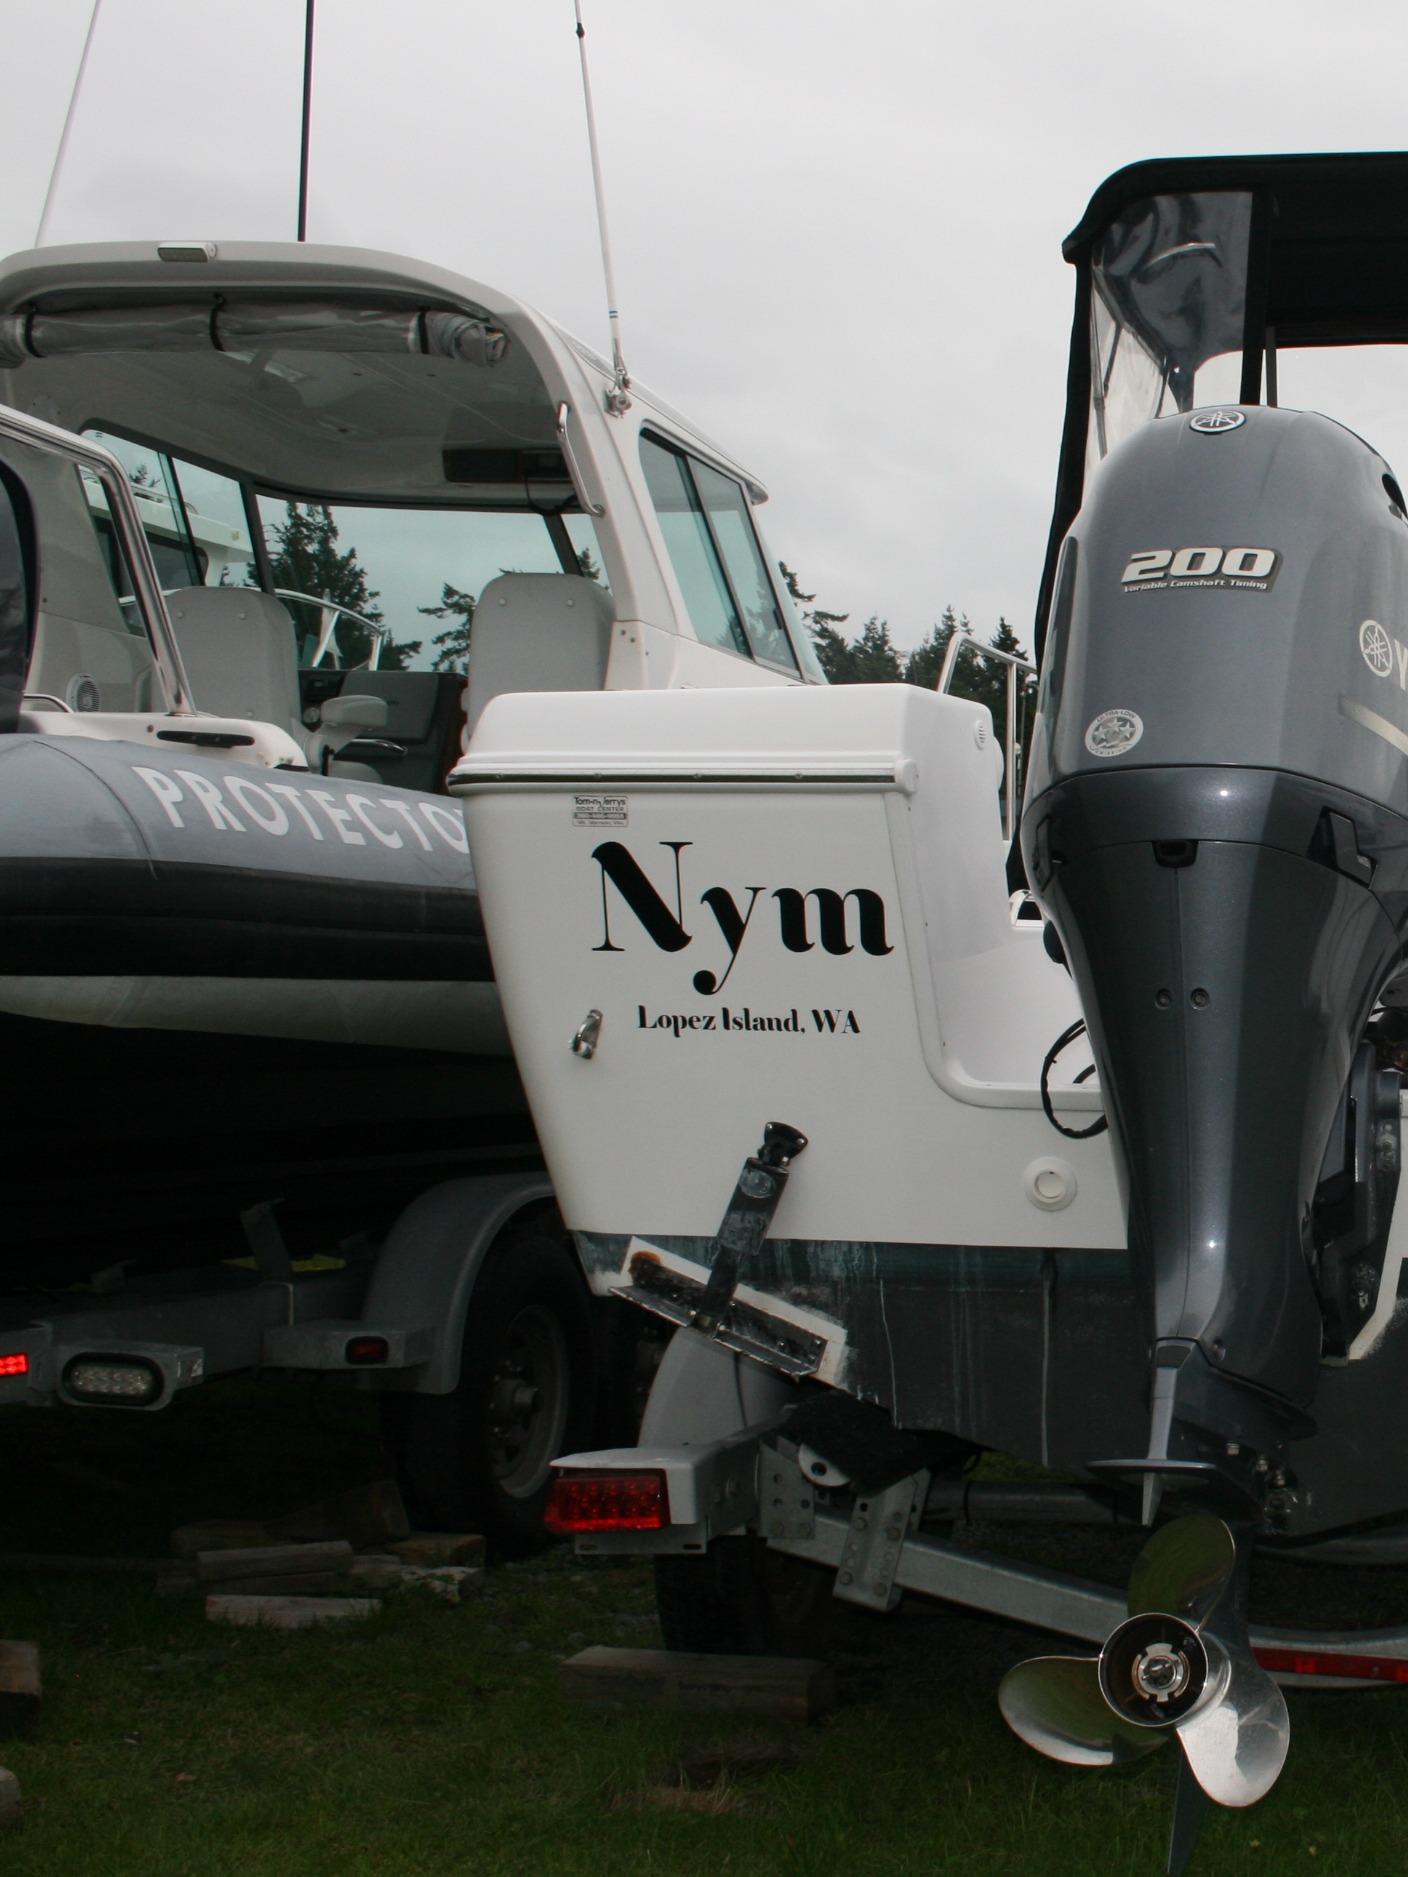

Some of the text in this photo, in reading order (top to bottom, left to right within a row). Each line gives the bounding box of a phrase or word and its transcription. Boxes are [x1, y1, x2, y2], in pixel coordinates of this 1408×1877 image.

[1120, 547, 1275, 583] 200
[1124, 579, 1268, 593] Variable Camshaft Timing
[132, 766, 470, 854] PROTECTO
[591, 841, 895, 996] Nym
[637, 1005, 861, 1038] Lopez Island, WA
